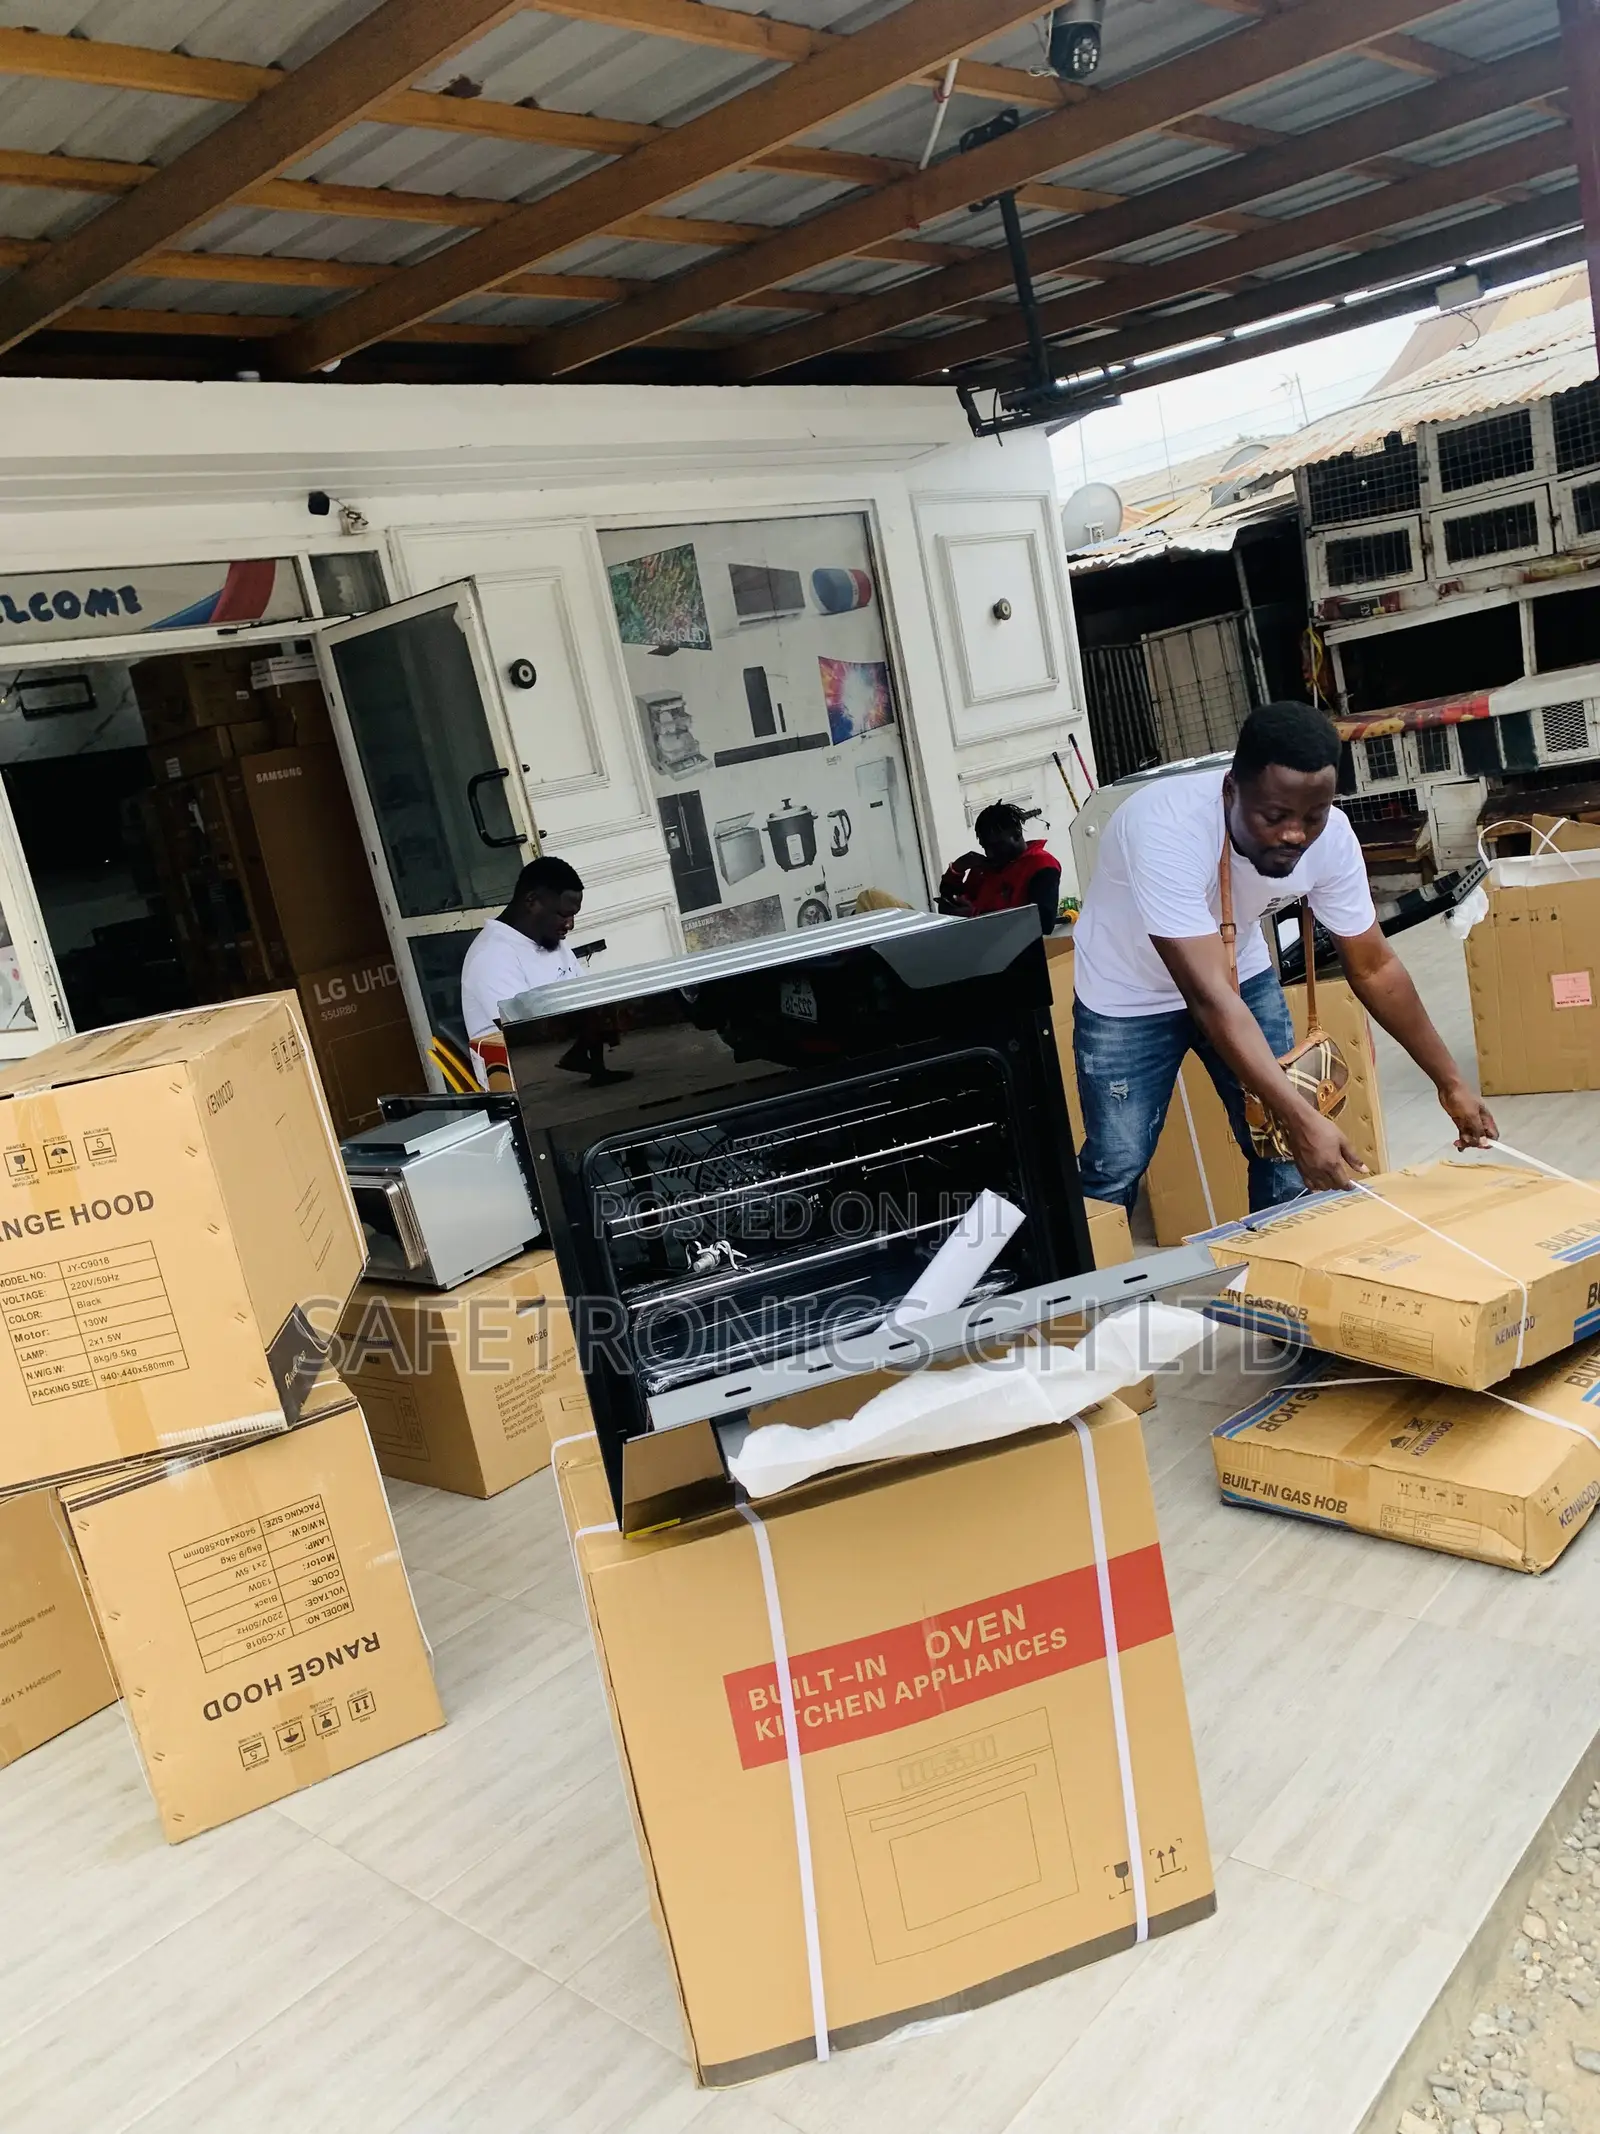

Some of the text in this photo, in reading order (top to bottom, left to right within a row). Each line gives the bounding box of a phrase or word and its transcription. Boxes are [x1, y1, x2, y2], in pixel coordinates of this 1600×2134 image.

[0, 585, 142, 624] LCOME
[256, 766, 302, 784] SAMSUNG
[313, 964, 400, 1005] LG UHD
[206, 1080, 234, 1116] KENWOOD
[96, 1138, 104, 1148] 5
[0, 1190, 154, 1242] NGE HOOD
[67, 1257, 110, 1273] JY-C9018
[30, 1271, 47, 1280] NO:
[70, 1274, 120, 1291] 220V/50Hz
[3, 1290, 47, 1306] VOLTAGE:
[76, 1297, 102, 1309] Black
[1244, 1293, 1273, 1310] GAS
[1276, 1299, 1309, 1321] HOB
[8, 1310, 43, 1325] COLOR:
[83, 1315, 108, 1328] 130W
[14, 1328, 50, 1343] Motor:
[1495, 1315, 1536, 1346] KENWOD
[20, 1349, 48, 1362] LAMP:
[93, 1348, 138, 1364] 8kg/9.5kg
[26, 1365, 65, 1380] N.W/G.W:
[31, 1378, 94, 1399] PACKING SIZE:
[1256, 1404, 1301, 1433] HOB
[1412, 1421, 1454, 1457] KENWOOD
[1222, 1472, 1348, 1514] BUILT-IN GAS HOB
[263, 1501, 320, 1529] PACKING SIZE:
[289, 1518, 325, 1537] N.W/G.W:
[305, 1535, 330, 1551] LAMP:
[220, 1543, 263, 1564] 8kg/9.5kg
[303, 1552, 336, 1570] Motor:
[248, 1578, 272, 1592] 130W
[309, 1569, 340, 1586] COLOR:
[254, 1594, 278, 1608] Black
[304, 1586, 345, 1607] VOLTAGE:
[237, 1611, 283, 1635] 220V/50Hz
[305, 1602, 350, 1625] MODEL NO:
[246, 1627, 286, 1650] JY-C9018
[926, 1603, 1026, 1660] OVEN
[203, 1632, 381, 1722] RANGE HOOD
[755, 1627, 1068, 1742] KICHEN APPLIANCES
[249, 1750, 257, 1760] 5
